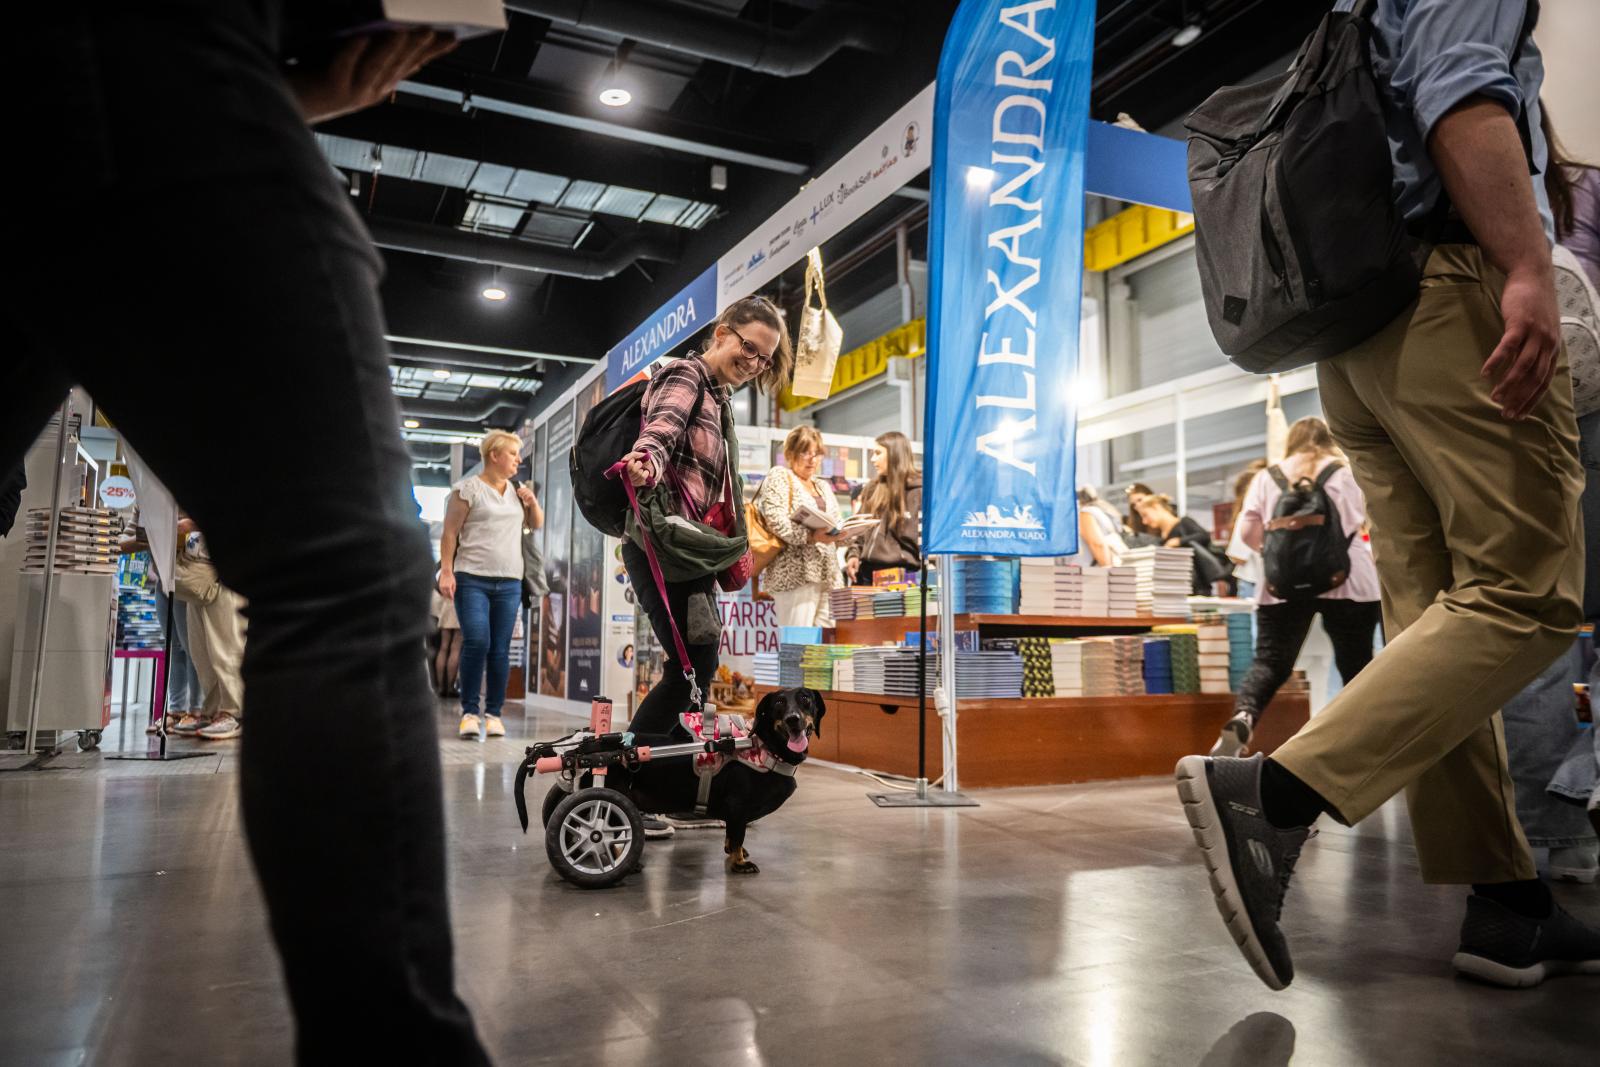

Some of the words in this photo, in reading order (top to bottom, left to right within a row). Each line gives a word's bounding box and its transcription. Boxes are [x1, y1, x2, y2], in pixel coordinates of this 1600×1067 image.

[975, 0, 1056, 477] ALEXANDRA
[621, 297, 696, 376] ALEXANDRA
[102, 486, 134, 498] -25%
[961, 529, 1016, 539] ALEXANDRA
[718, 601, 778, 628] TARR'S
[719, 630, 779, 656] ALLBA
